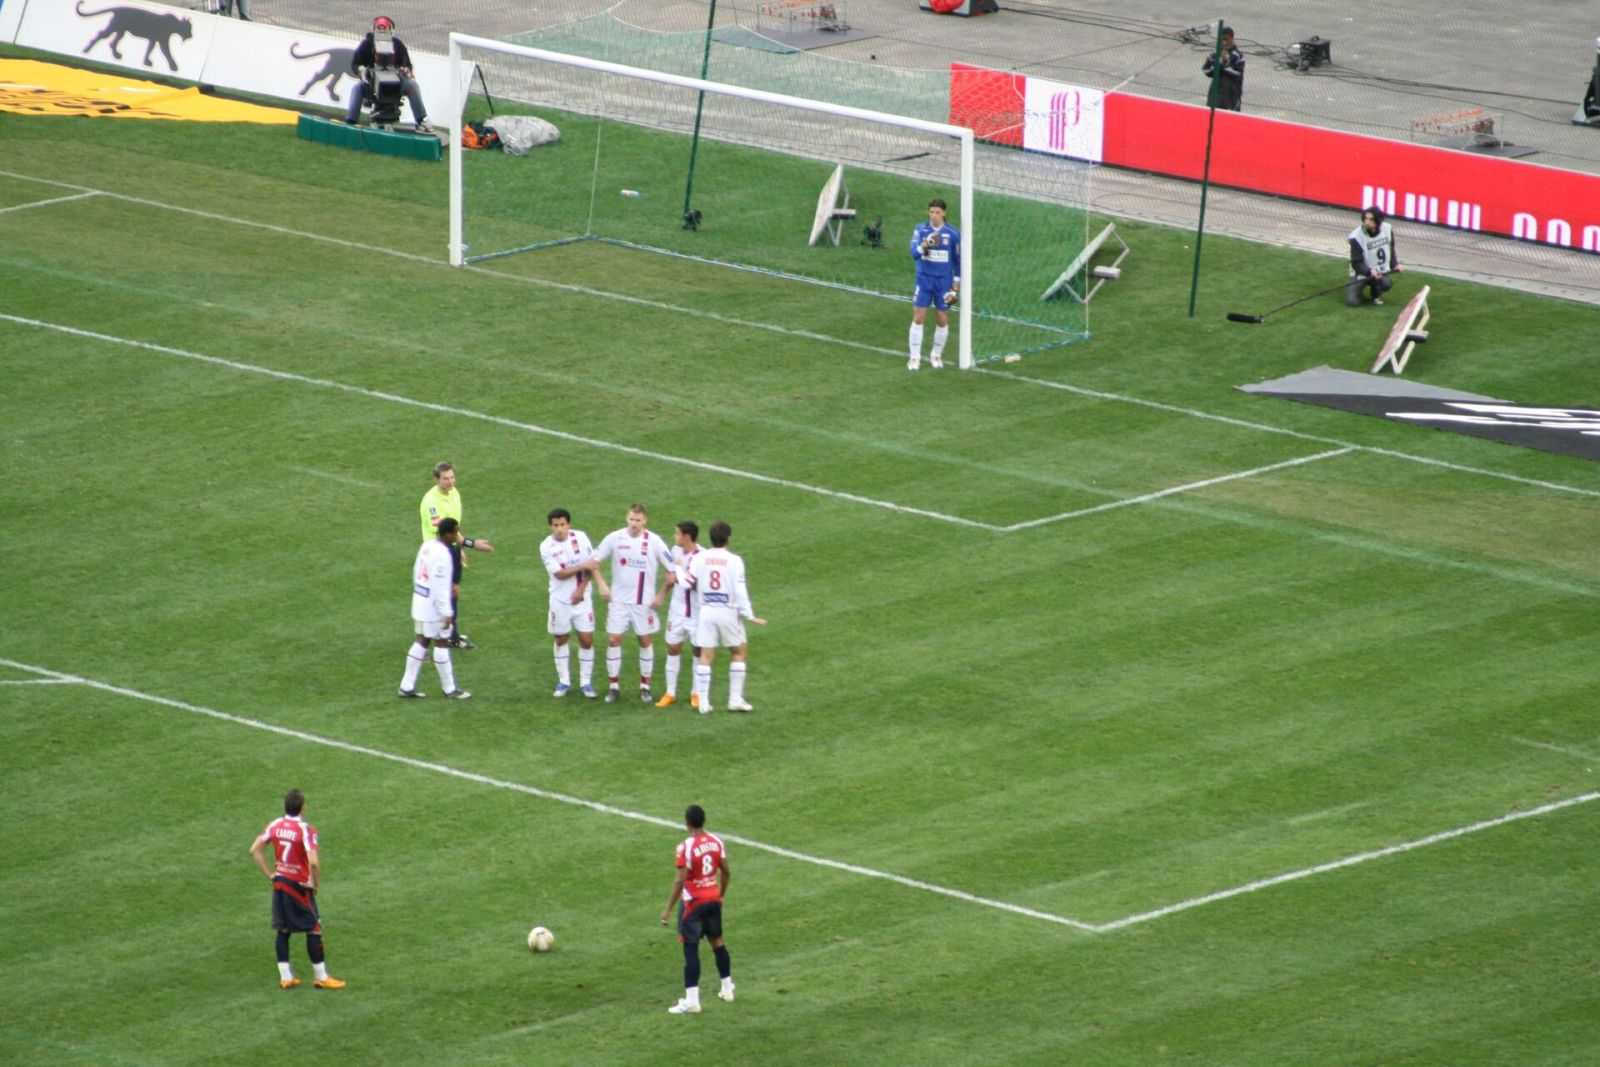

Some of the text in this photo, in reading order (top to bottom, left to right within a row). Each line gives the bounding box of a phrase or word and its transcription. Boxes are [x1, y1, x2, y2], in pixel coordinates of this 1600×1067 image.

[1376, 247, 1386, 266] 9
[710, 570, 721, 590] 8
[279, 840, 291, 863] 7
[702, 854, 712, 875] 8
